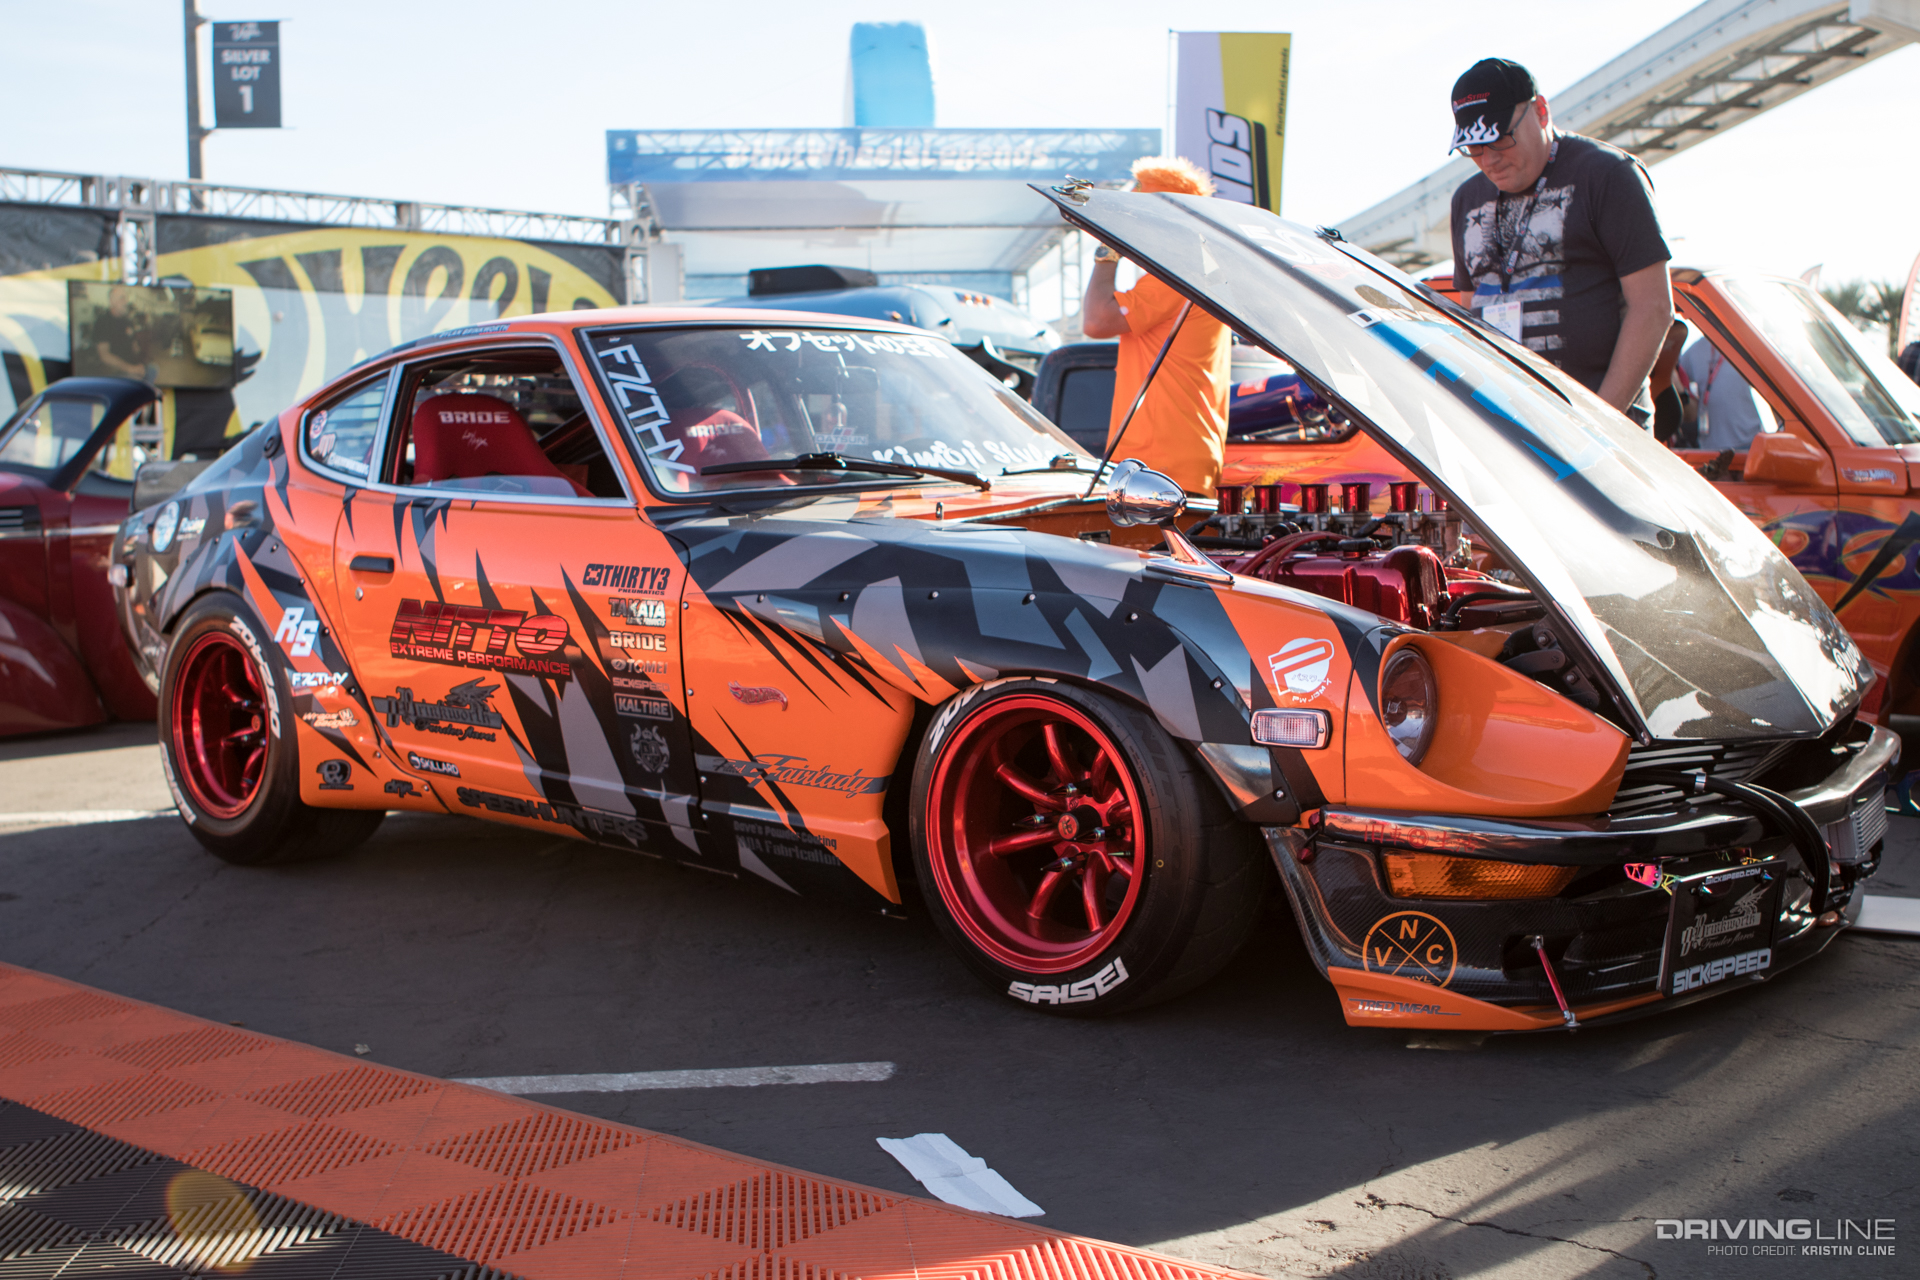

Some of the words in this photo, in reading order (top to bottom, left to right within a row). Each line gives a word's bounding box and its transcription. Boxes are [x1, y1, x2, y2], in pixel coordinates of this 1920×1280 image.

[222, 49, 271, 65] SILVER
[231, 66, 261, 81] LOT
[239, 85, 253, 113] 1
[438, 411, 511, 424] BRIDE
[815, 434, 868, 445] DATSUN
[602, 564, 670, 590] THIRTY3
[608, 597, 666, 618] TAKATA
[390, 598, 570, 655] NITTO
[609, 630, 667, 652] BRIDE
[390, 643, 454, 661] EXTREME
[457, 651, 570, 676] PERFORMANCE
[626, 658, 668, 674] TOMEI
[612, 677, 671, 692] SICKSPEED
[419, 757, 460, 776] SKILLARD
[749, 754, 875, 798] Fairlady
[456, 786, 648, 841] SPEEDHUNTERS
[801, 832, 838, 850] Coating
[1705, 868, 1761, 885] SICKSPEED.COM
[1700, 936, 1732, 950] Fender
[1672, 948, 1772, 994] SICKSPEED
[1352, 998, 1395, 1012] TRED
[1395, 1001, 1450, 1015] WEAR
